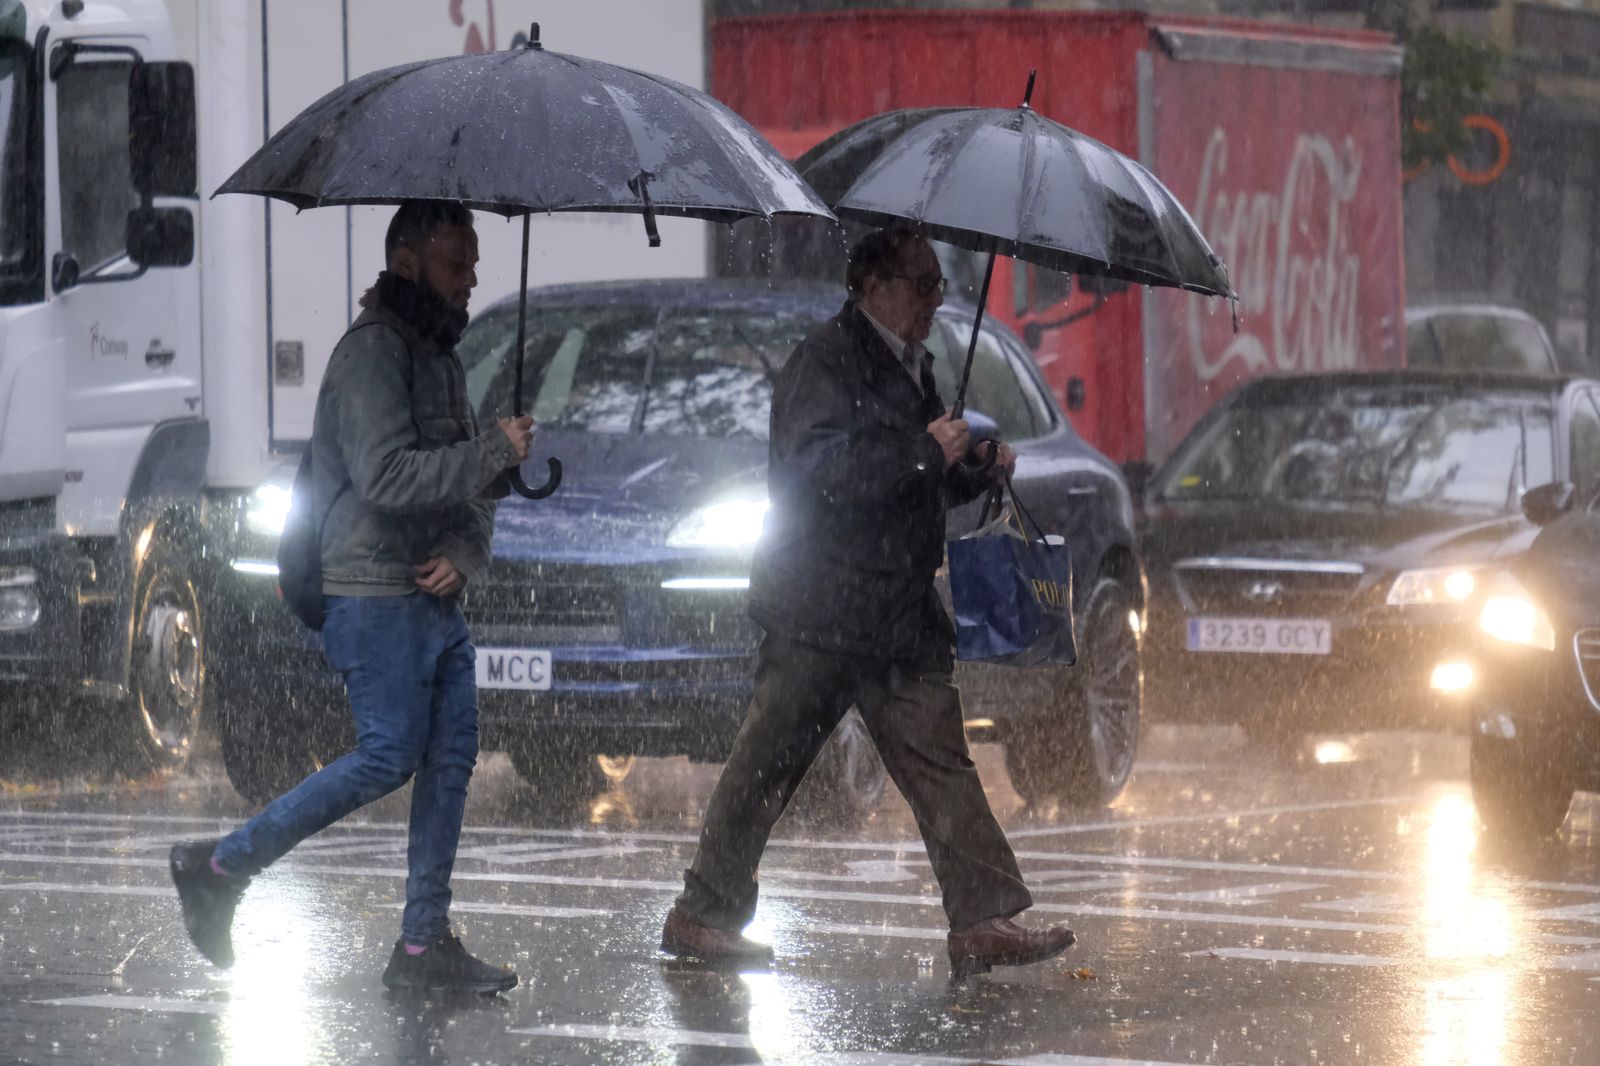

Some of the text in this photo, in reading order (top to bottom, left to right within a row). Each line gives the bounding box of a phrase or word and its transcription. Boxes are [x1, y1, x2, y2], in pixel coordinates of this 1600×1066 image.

[1204, 623, 1325, 649] 3239 GCY
[487, 654, 544, 683] MCC
